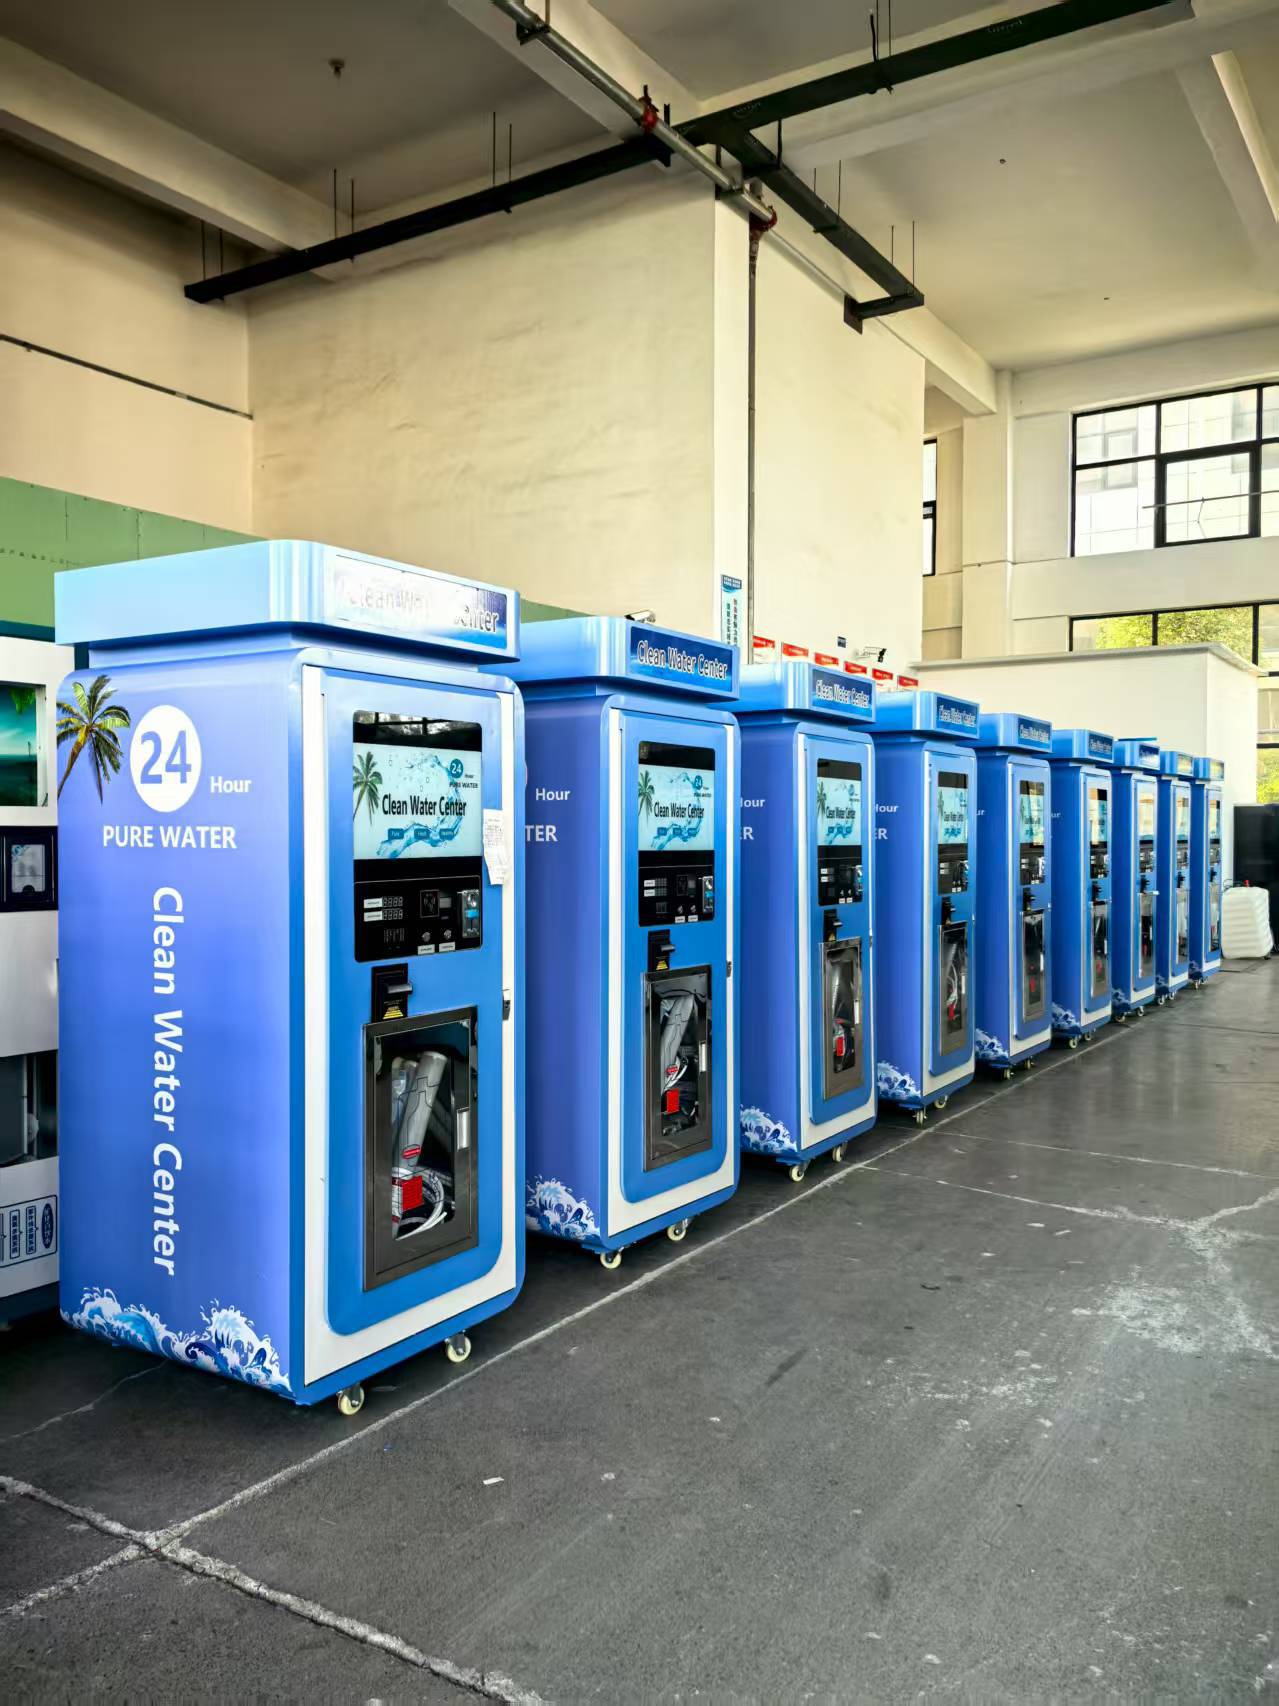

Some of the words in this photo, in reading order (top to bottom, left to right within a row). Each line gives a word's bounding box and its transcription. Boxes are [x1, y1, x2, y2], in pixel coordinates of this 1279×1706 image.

[637, 639, 666, 668] Clean
[668, 646, 697, 674] Water
[697, 653, 729, 680] Center
[140, 730, 192, 784] 24
[451, 764, 463, 775] 24
[209, 775, 252, 793] Hour
[535, 788, 571, 801] Hour
[381, 793, 408, 816] Clean
[410, 795, 437, 816] Water
[438, 796, 467, 817] Center
[653, 801, 670, 818] Clean
[670, 802, 687, 818] Water
[687, 803, 705, 819] Center
[102, 825, 154, 847] PURE
[159, 825, 238, 849] WATER
[525, 824, 558, 842] TER
[152, 886, 185, 995] Clean
[153, 1009, 184, 1132] Water
[152, 1142, 183, 1277] Center
